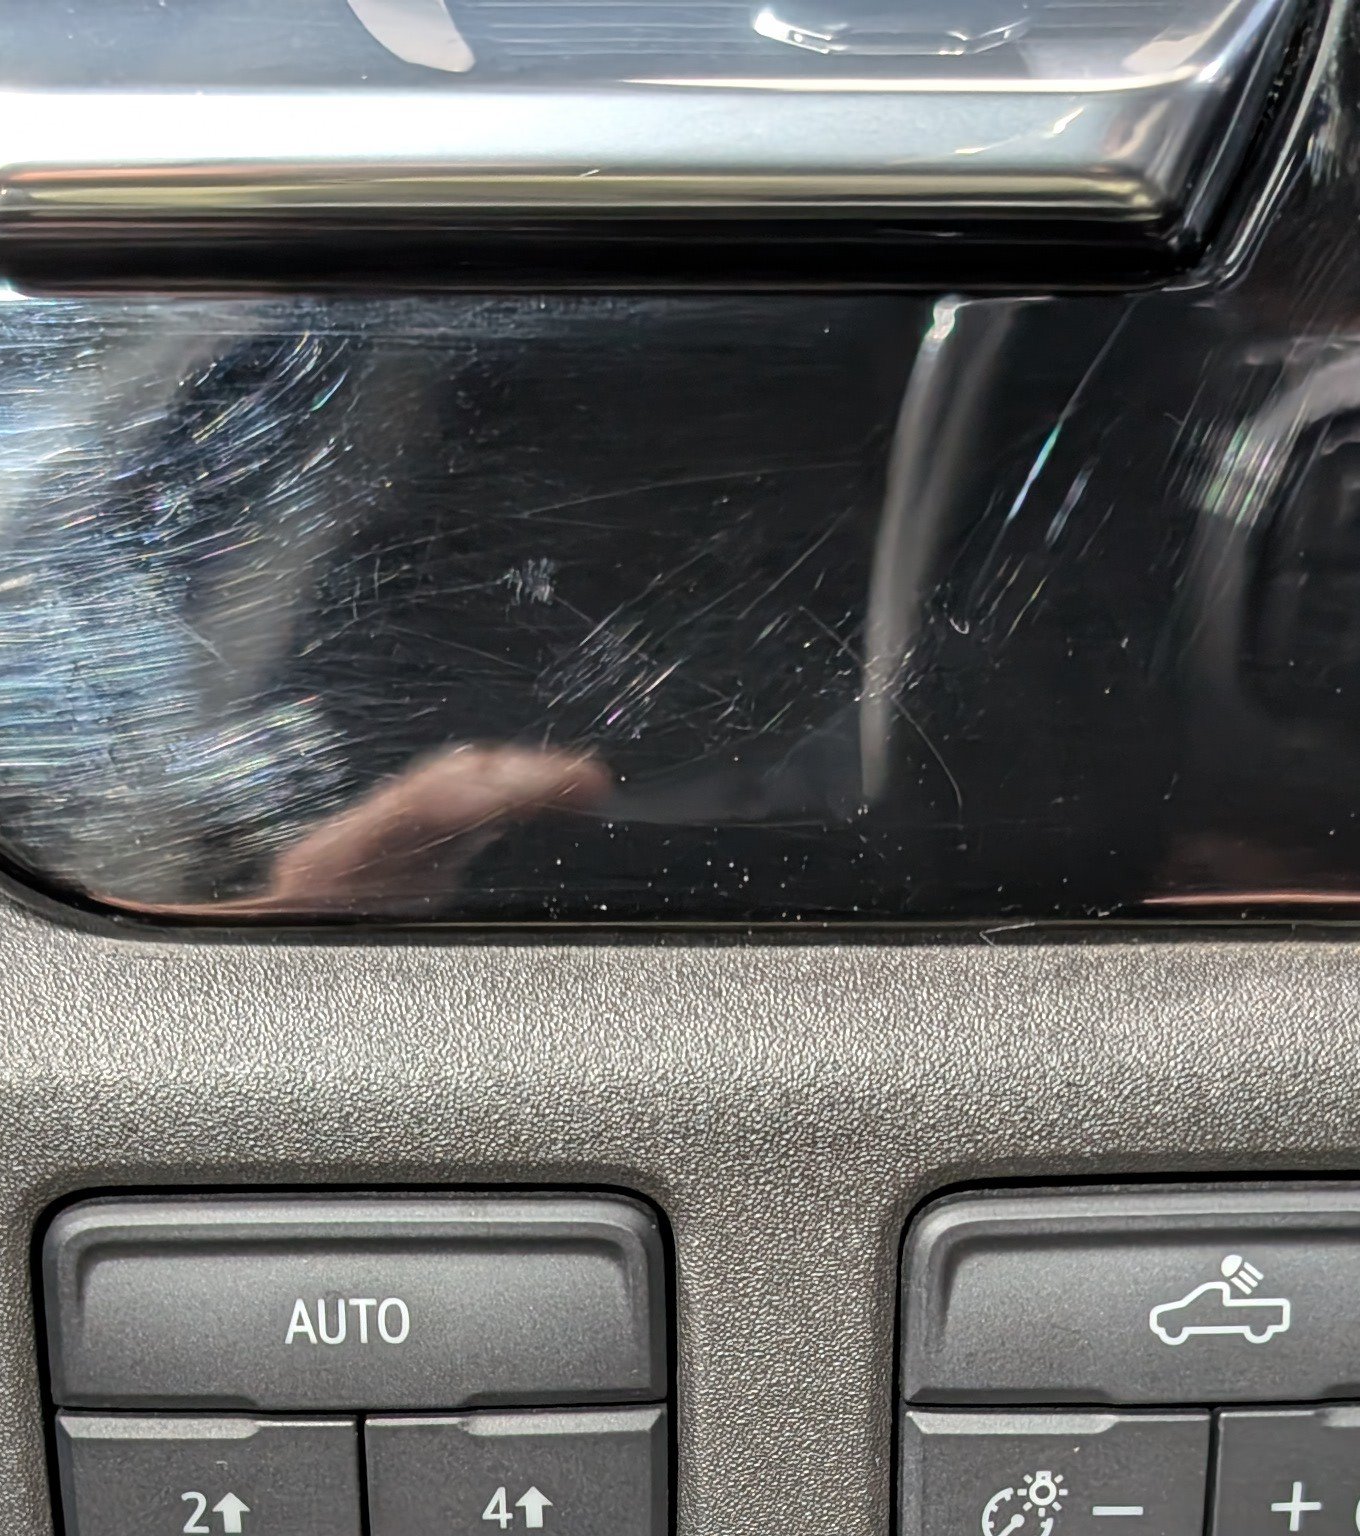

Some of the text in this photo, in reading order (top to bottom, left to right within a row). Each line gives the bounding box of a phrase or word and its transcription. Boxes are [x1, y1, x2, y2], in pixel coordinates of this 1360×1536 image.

[285, 1297, 410, 1344] AUTO
[181, 1490, 209, 1534] 2
[482, 1485, 512, 1529] 4
